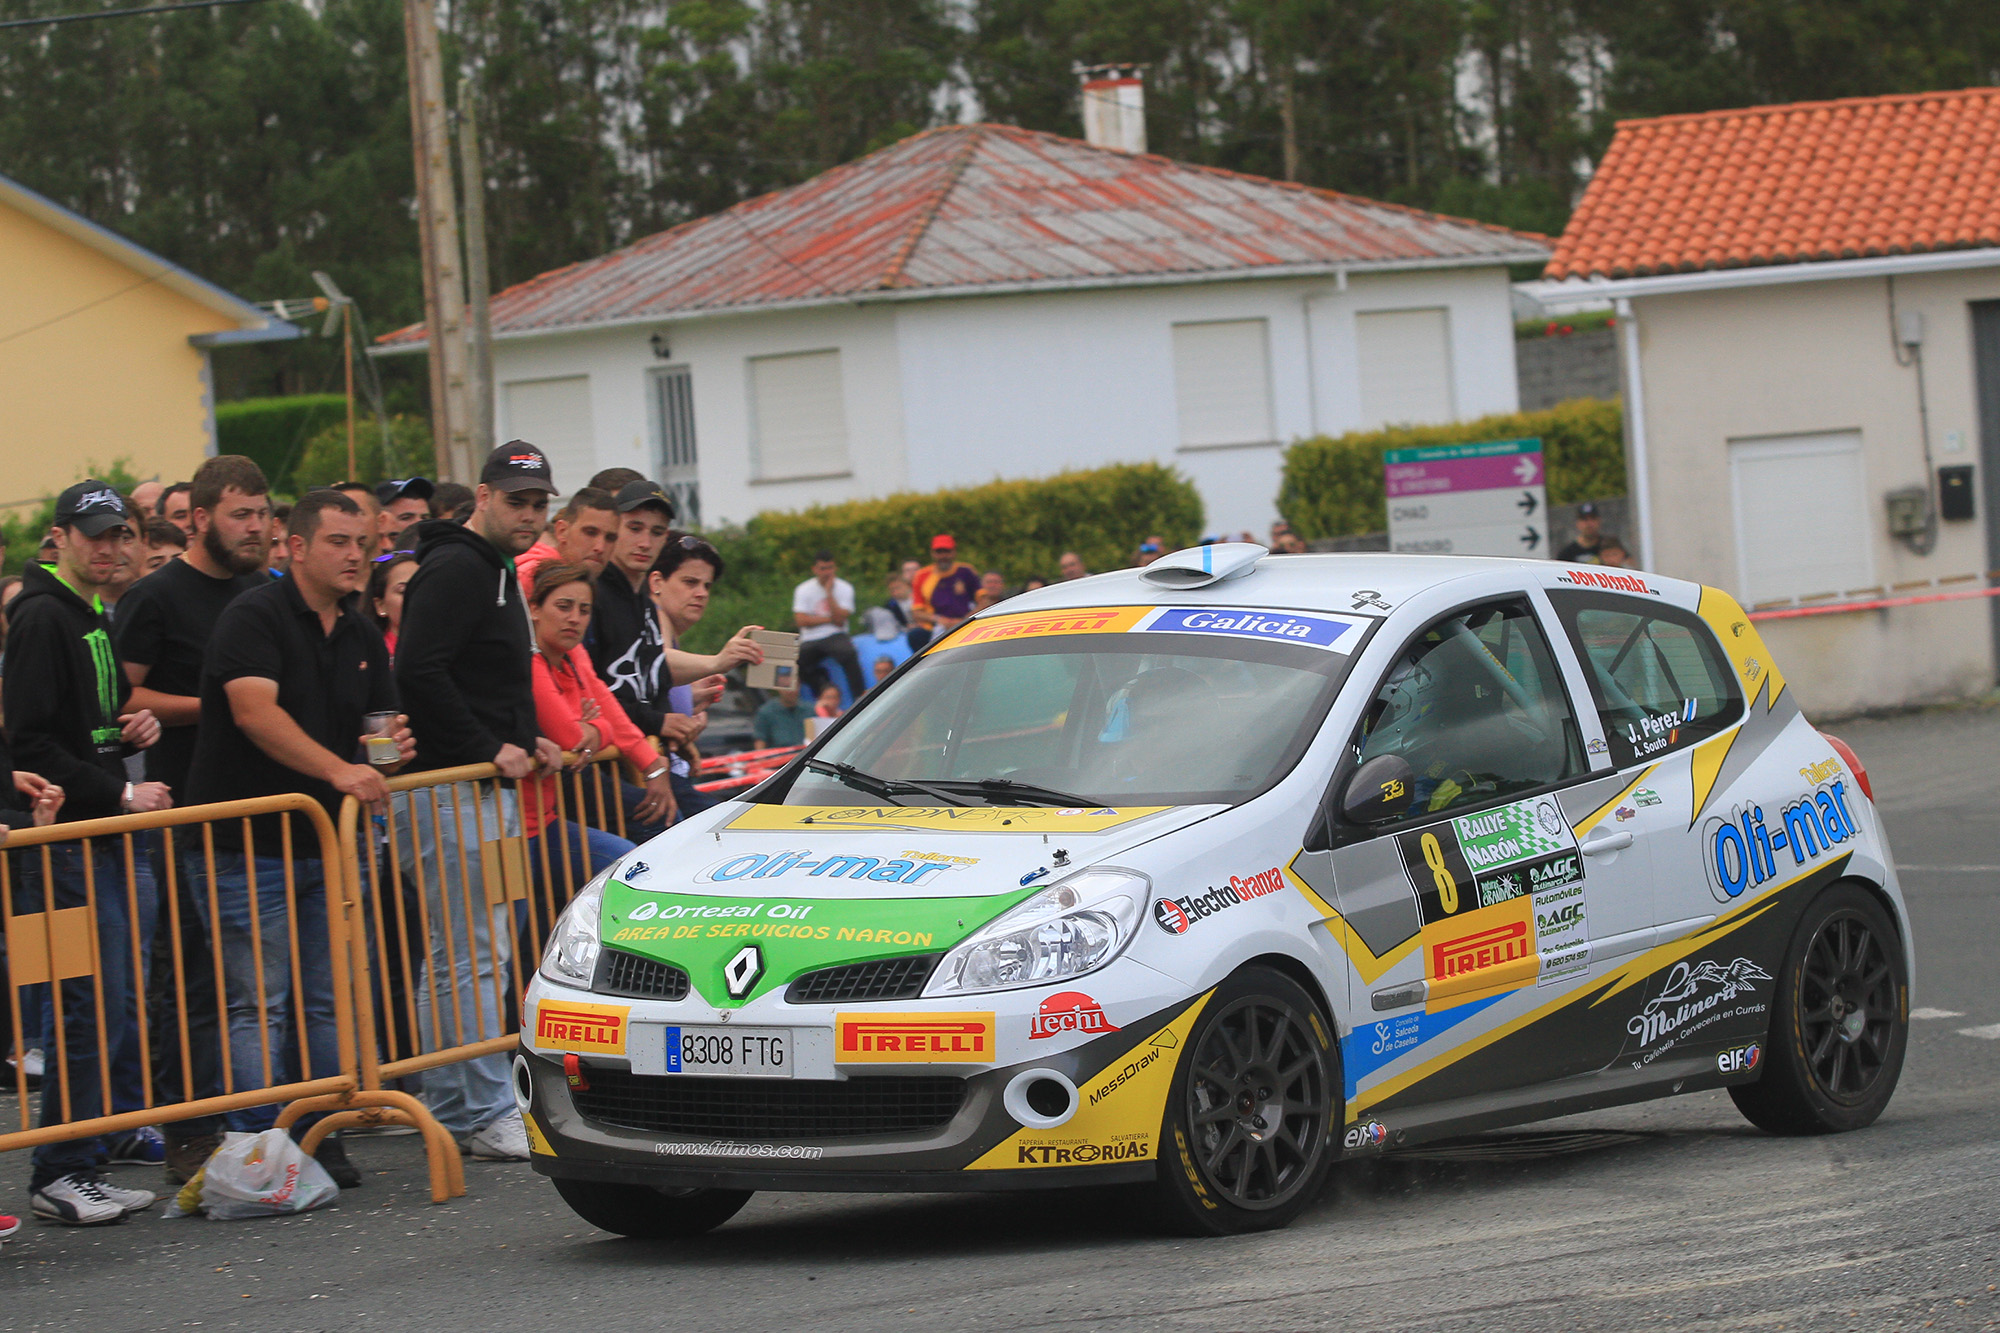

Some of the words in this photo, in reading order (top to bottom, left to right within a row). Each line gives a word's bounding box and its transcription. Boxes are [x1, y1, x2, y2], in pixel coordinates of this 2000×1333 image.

[958, 611, 1120, 645] PIRELLI
[1181, 612, 1314, 638] Galicia
[1627, 723, 1642, 744] J.
[1640, 710, 1682, 738] Pérez
[1634, 744, 1644, 758] A.
[1643, 737, 1668, 756] Souto
[1798, 756, 1843, 787] Talleres
[1457, 811, 1508, 841] RALLYE
[1713, 779, 1857, 898] Oli-mar
[711, 850, 952, 885] Oli-mar
[901, 850, 981, 866] Talleres
[1465, 837, 1522, 868] NARÓN
[1420, 832, 1459, 914] 8
[1540, 855, 1577, 881] AGC
[1174, 867, 1286, 925] ElectroGranxa
[1535, 886, 1583, 907] Automóviles
[658, 903, 764, 919] Ortegal
[767, 904, 815, 920] Oil
[1546, 902, 1584, 927] AGC
[613, 925, 670, 941] AREA
[674, 924, 702, 940] DE
[706, 923, 830, 941] SERVICIOS
[836, 927, 933, 947] NARON
[1432, 920, 1528, 981] PIRELLI
[1643, 961, 1699, 1016] La
[537, 1008, 622, 1045] PIRELLI
[1626, 987, 1738, 1048] Molinera
[842, 1022, 986, 1052] PIRELLI
[1643, 1041, 1675, 1065] Cafetería
[1680, 1014, 1722, 1039] Cervecería
[1722, 1009, 1734, 1019] en
[1735, 1003, 1766, 1016] Currás
[670, 1054, 678, 1066] E
[682, 1034, 734, 1065] 8308
[742, 1036, 784, 1067] FTG
[1717, 1048, 1744, 1073] elf
[1088, 1048, 1161, 1107] MessDraw
[654, 1140, 824, 1160] www.frimos.com
[1047, 1138, 1089, 1147] RESTAURANTE
[1110, 1132, 1149, 1143] SALVATIERRA
[1343, 1124, 1371, 1149] elf
